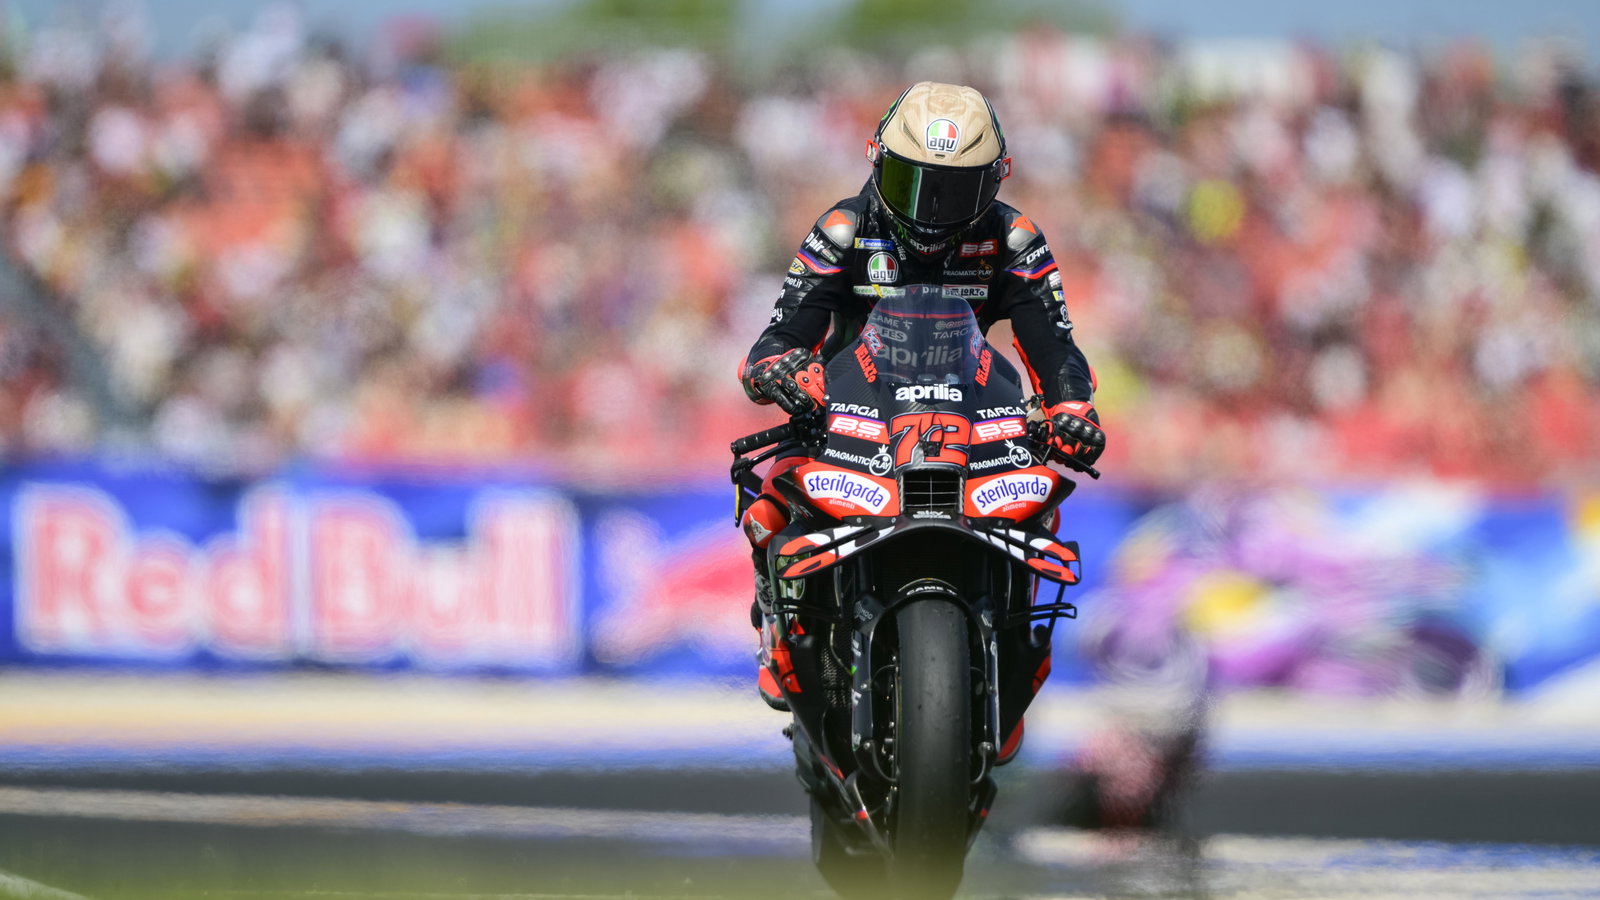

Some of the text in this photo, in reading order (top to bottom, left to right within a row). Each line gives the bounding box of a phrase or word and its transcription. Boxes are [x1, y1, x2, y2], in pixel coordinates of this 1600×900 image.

[929, 137, 955, 150] agv
[873, 270, 896, 280] agv
[895, 383, 962, 402] aprilia
[830, 403, 879, 419] TARGA
[976, 406, 1027, 419] TARGA
[831, 416, 886, 436] BS
[975, 420, 1024, 438] BS
[889, 411, 971, 471] 72
[824, 448, 890, 470] PRAGMATIC PLAY
[969, 453, 1029, 471] PRAGMATIC PLAY
[808, 474, 884, 507] sterilgarda
[976, 476, 1048, 508] sterilgarda
[829, 498, 856, 510] alimenti
[1002, 501, 1027, 512] alimenti
[20, 485, 577, 663] Red Bull
[906, 585, 944, 596] CAME
